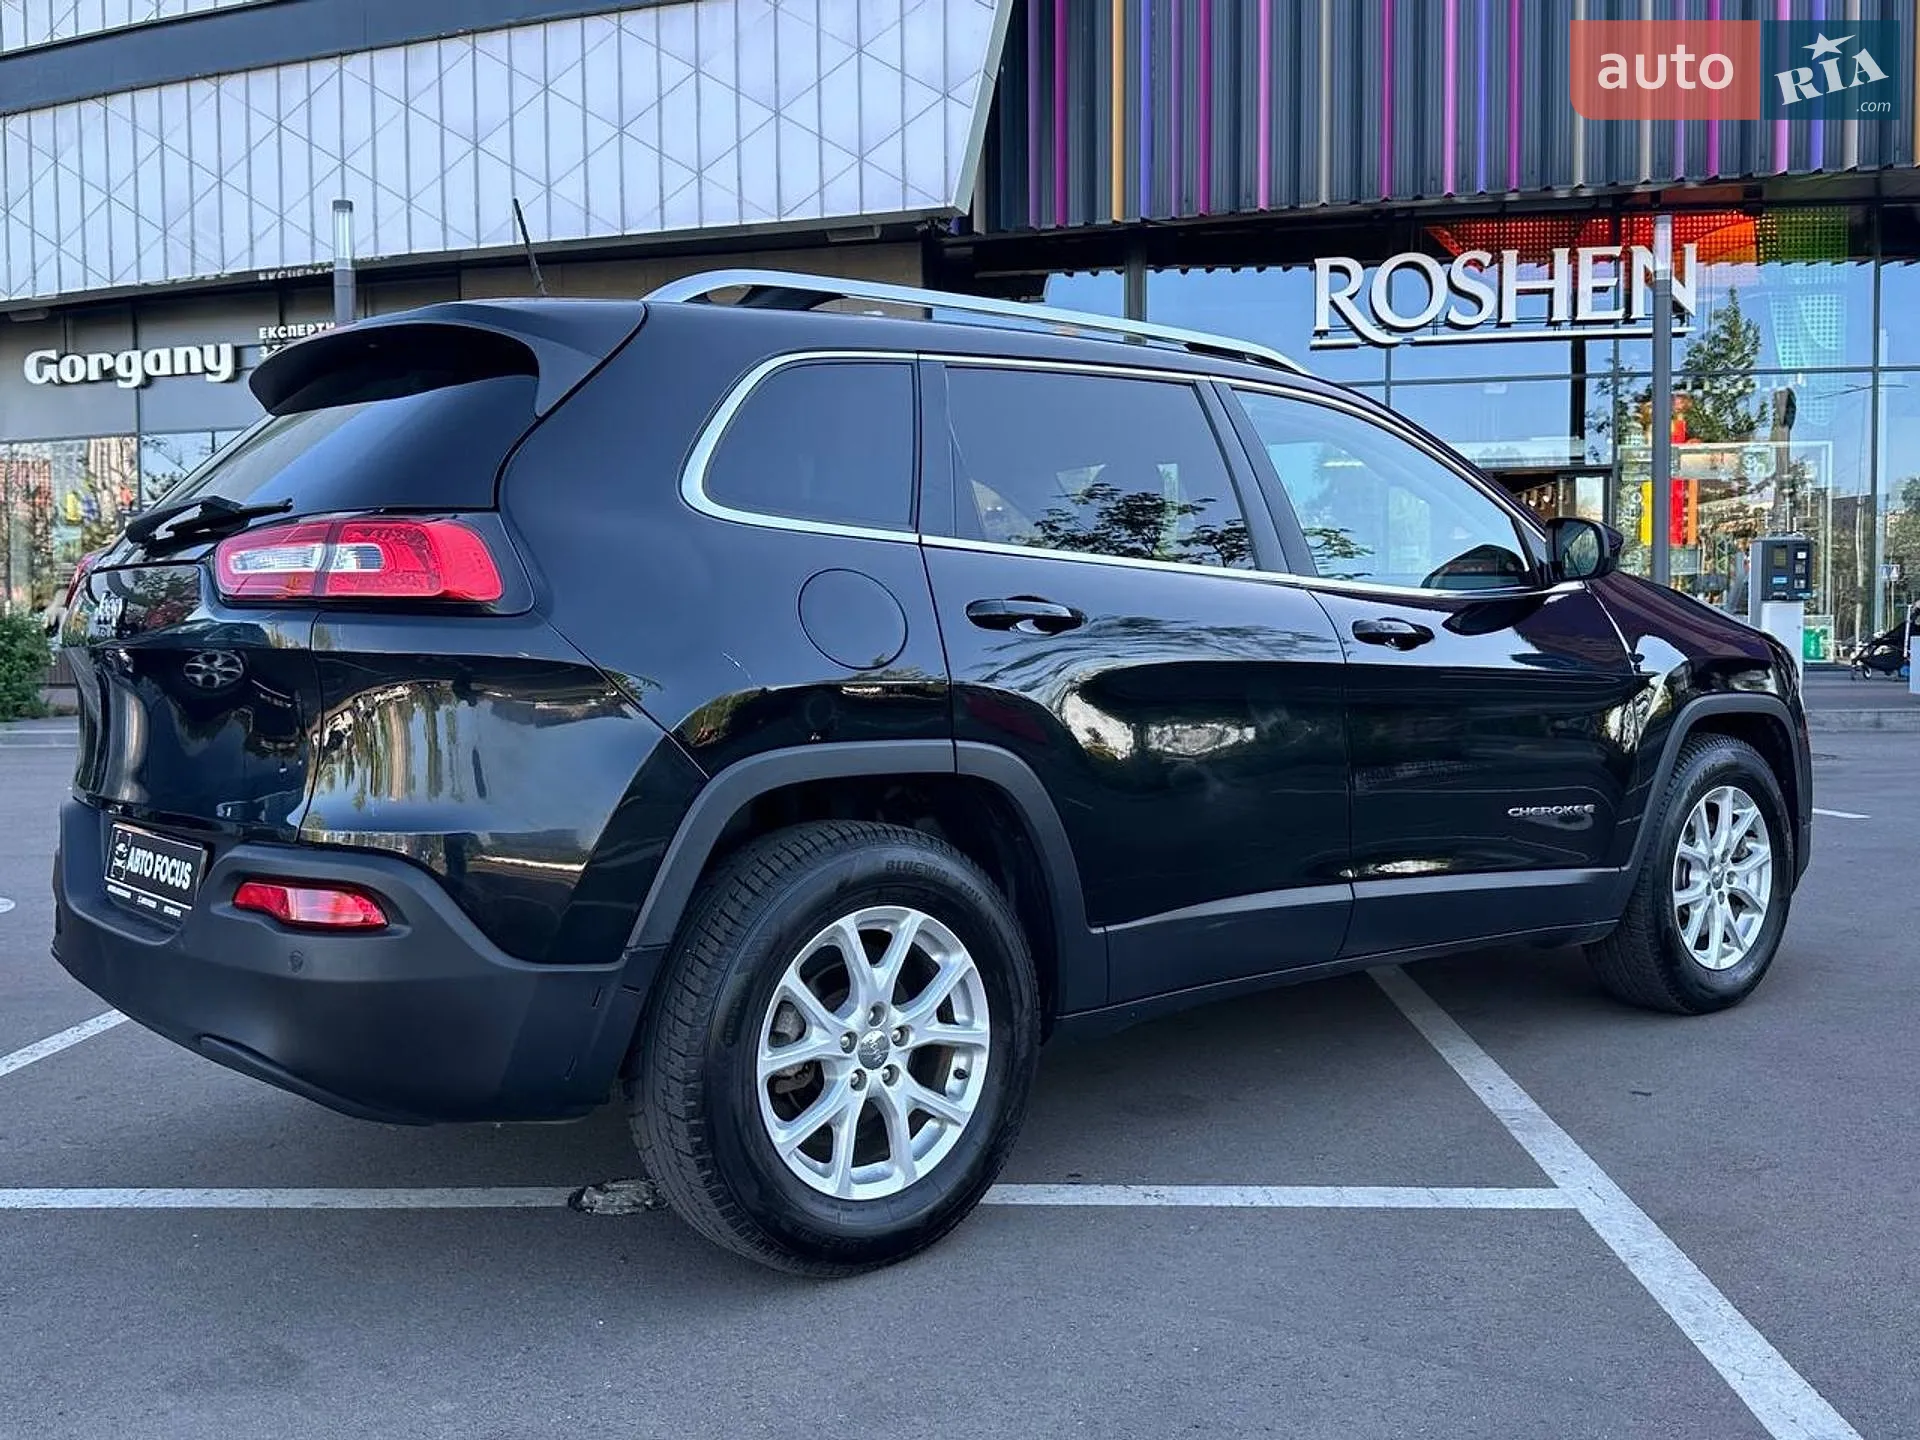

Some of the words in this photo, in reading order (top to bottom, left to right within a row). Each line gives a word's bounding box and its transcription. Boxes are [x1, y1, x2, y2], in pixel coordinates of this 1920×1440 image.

[1313, 243, 1698, 345] ROSHEN
[24, 343, 236, 388] Gorgany
[1508, 804, 1595, 817] CHEROKEE
[152, 853, 192, 890] FOCUS
